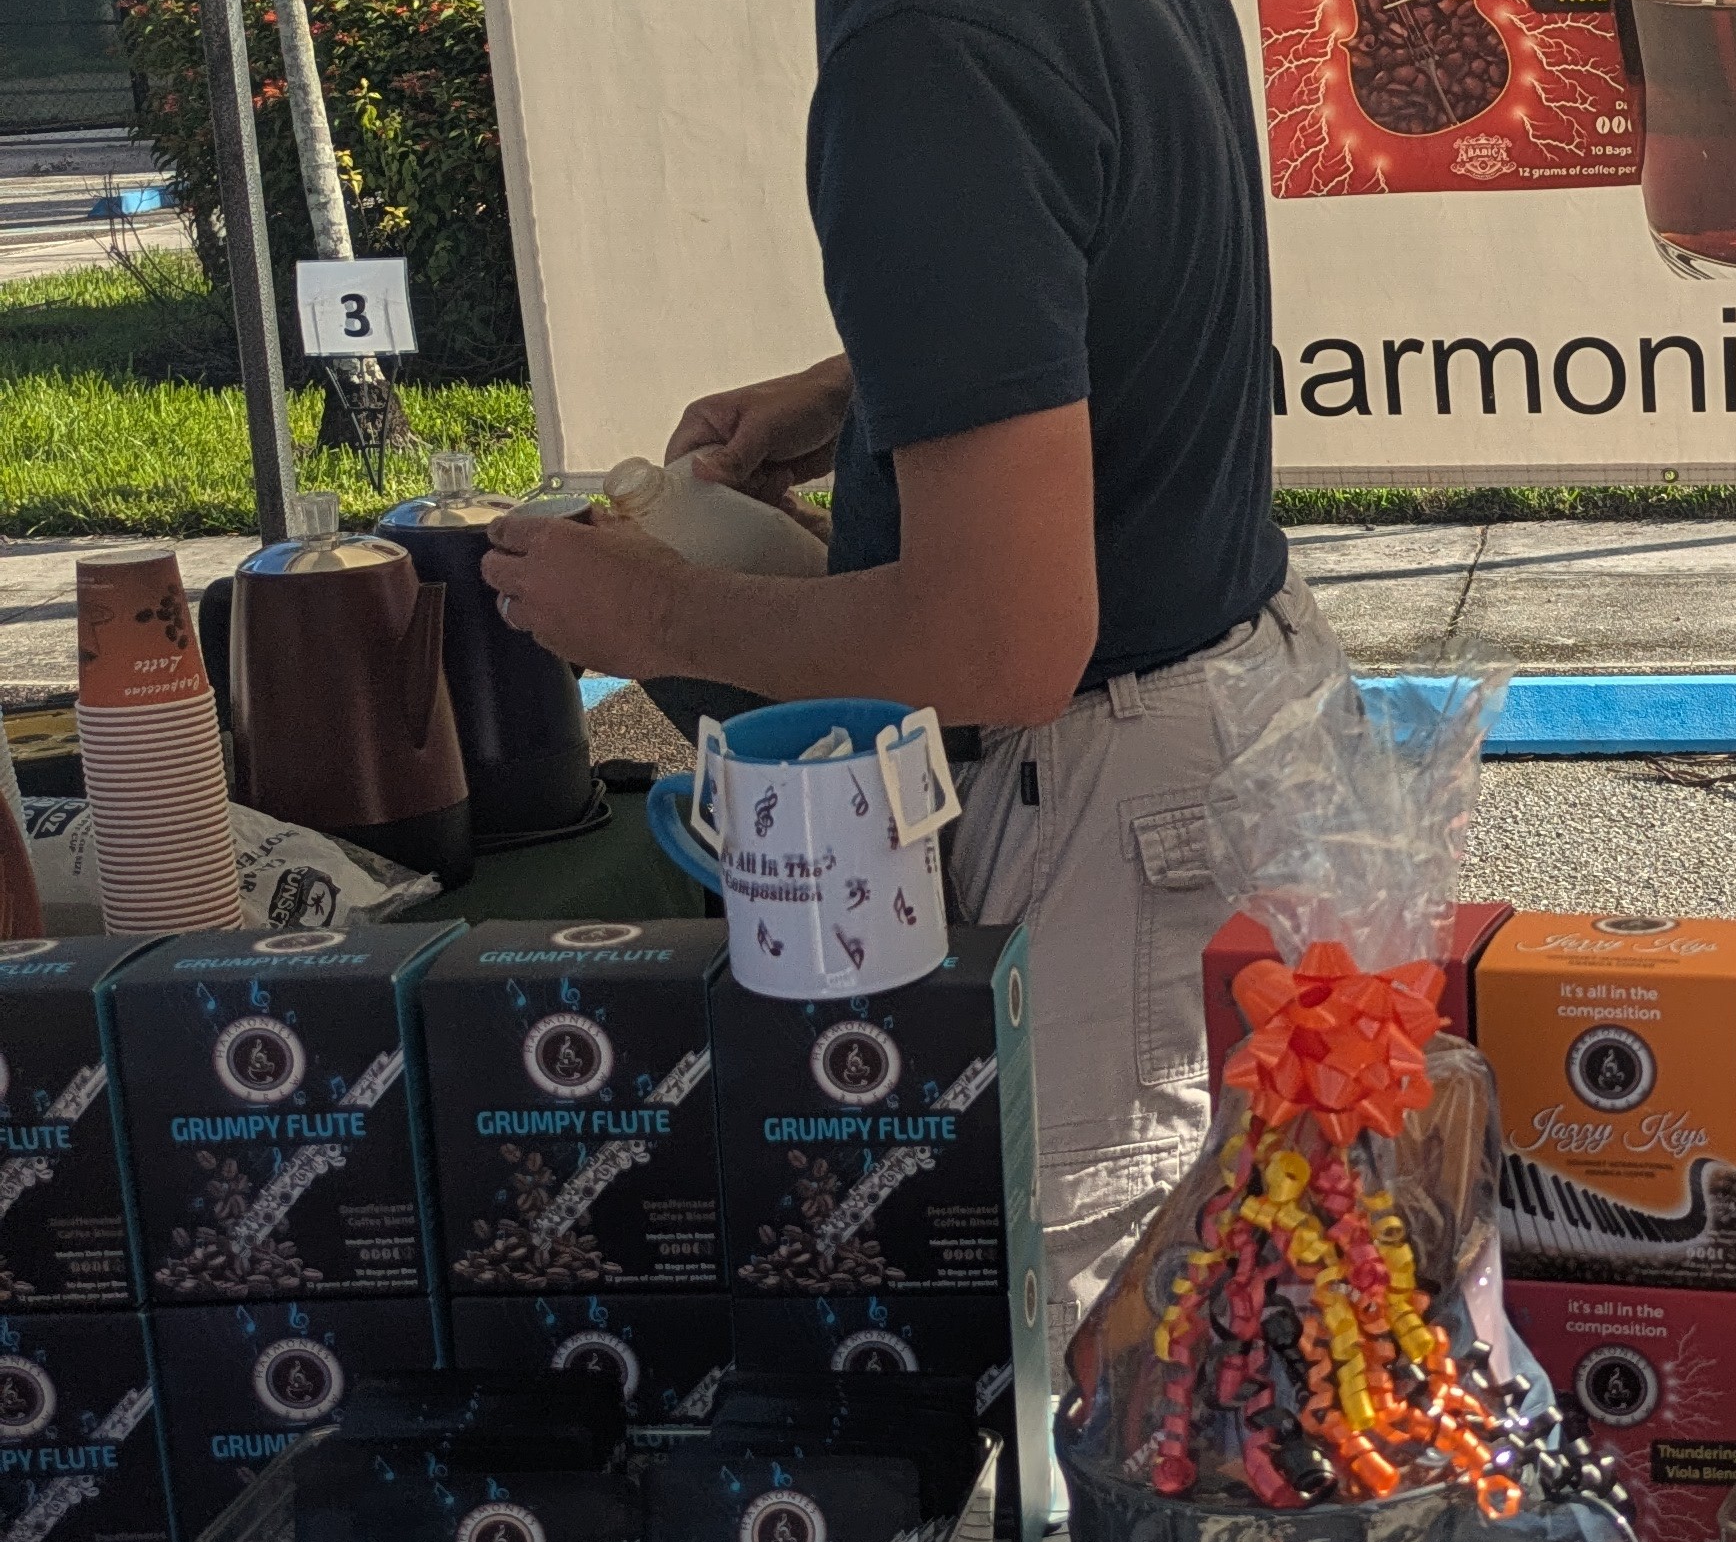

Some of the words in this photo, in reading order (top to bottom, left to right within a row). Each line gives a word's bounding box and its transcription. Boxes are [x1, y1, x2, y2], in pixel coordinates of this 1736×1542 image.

[1605, 146, 1632, 156] Bags
[1519, 167, 1530, 176] 12
[1532, 167, 1566, 178] grams
[1569, 165, 1581, 174] of
[1583, 165, 1615, 175] coffee
[1618, 166, 1636, 178] per
[340, 293, 372, 338] 3
[134, 656, 183, 673] Latte
[124, 673, 199, 696] Cappuccino
[1517, 933, 1624, 953] Jazzy
[1633, 938, 1718, 956] Keys
[478, 950, 588, 965] GRUMPY
[593, 949, 674, 962] FLUTE
[1561, 983, 1584, 998] it's
[1587, 984, 1606, 998] all
[1611, 986, 1626, 1000] in
[1630, 987, 1658, 1001] the
[1557, 1005, 1661, 1020] composition
[170, 1118, 279, 1142] GRUMPY
[287, 1112, 367, 1137] FLUTE
[475, 1110, 586, 1137] GRUMPY
[592, 1109, 672, 1134] FLUTE
[763, 1116, 872, 1142] GRUMPY
[878, 1116, 957, 1140] FLUTE
[1510, 1104, 1613, 1154] Jazzy
[1623, 1111, 1709, 1158] Keys
[1568, 1299, 1591, 1313] it's
[1594, 1302, 1613, 1315] all
[1617, 1303, 1633, 1316] in
[1636, 1304, 1664, 1319] the
[1566, 1320, 1667, 1337] composition
[39, 1446, 118, 1469] FLUTE
[1666, 1465, 1700, 1478] Viola
